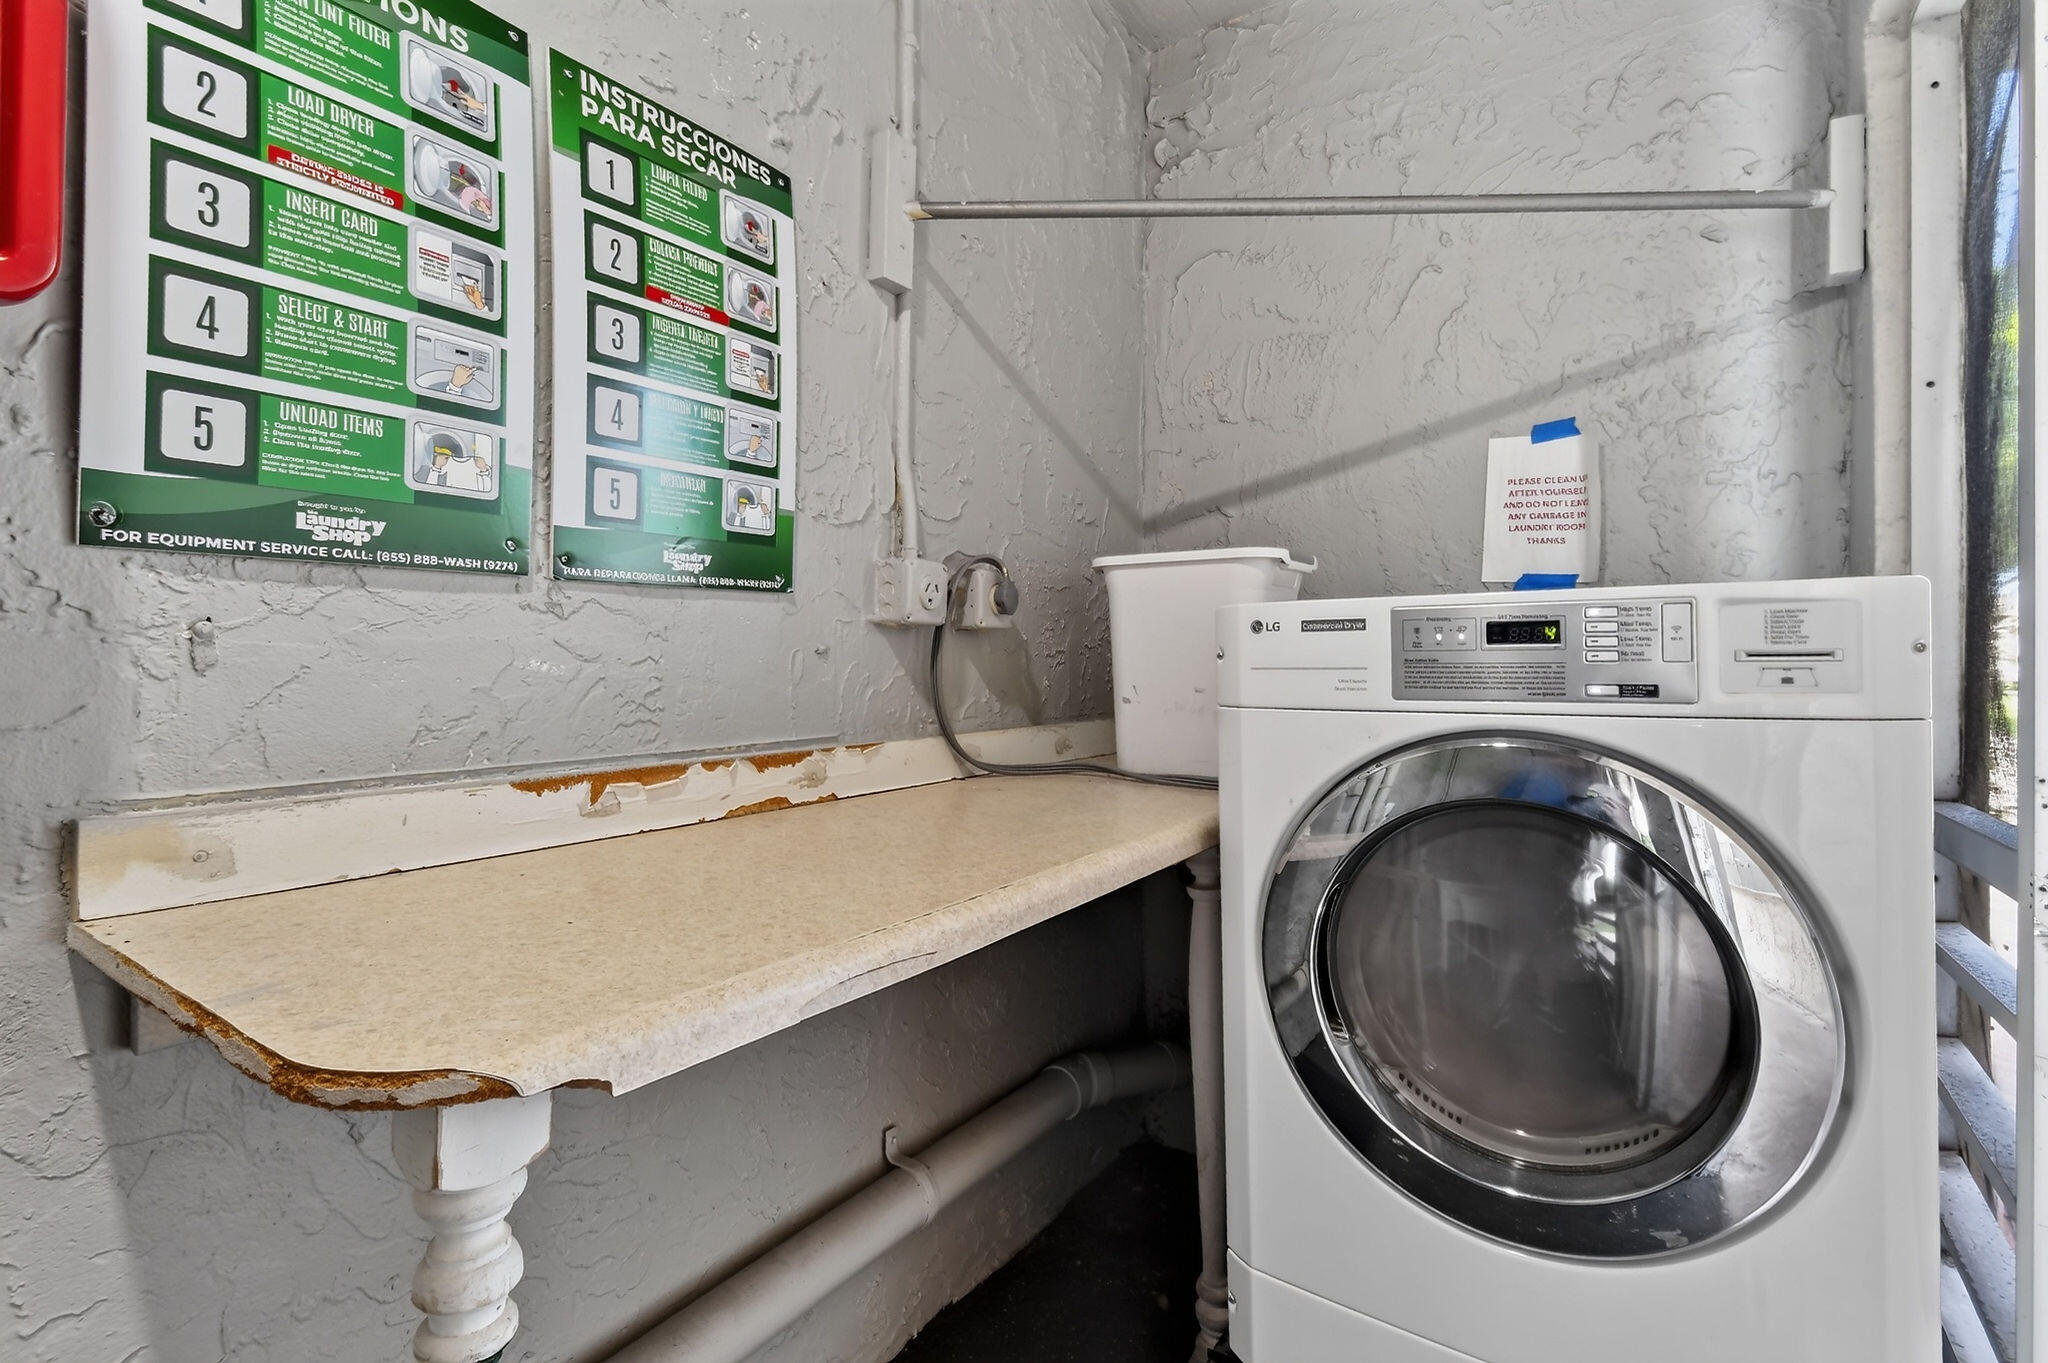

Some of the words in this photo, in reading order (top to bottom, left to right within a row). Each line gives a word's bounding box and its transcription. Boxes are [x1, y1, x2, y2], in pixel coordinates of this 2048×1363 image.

[348, 13, 391, 50] FILTER
[196, 70, 217, 118] 2
[288, 85, 325, 118] LOAD
[330, 103, 375, 138] DRYER
[579, 68, 772, 187] INSTRUCCIONES
[580, 93, 656, 150] PARA
[661, 135, 737, 190] SECAR
[374, 184, 386, 195] IS
[606, 158, 616, 191] 1
[198, 181, 220, 228] 3
[285, 189, 337, 223] INSERT
[341, 208, 378, 237] CARD
[609, 238, 621, 272] 2
[195, 295, 219, 340] 4
[278, 293, 330, 325] SELECT
[333, 308, 345, 329] &
[348, 312, 389, 340] START
[611, 317, 625, 351] 3
[193, 405, 213, 452] 5
[279, 401, 338, 430] UNLOAD
[343, 413, 384, 438] ITEMS
[610, 398, 625, 431] 4
[609, 477, 621, 510] 5
[1507, 477, 1541, 486] PLEASE
[1544, 476, 1577, 485] CLEAN
[1508, 489, 1538, 498] AFTER
[1503, 501, 1524, 509] AND
[1525, 500, 1541, 508] DO
[1543, 500, 1563, 508] NOT
[1508, 512, 1527, 520] ANY
[1529, 511, 1575, 520] GARBAGE
[1577, 511, 1587, 519] IN
[296, 510, 388, 538] Laundry
[1508, 524, 1554, 532] LAUNDRY
[1556, 523, 1586, 531] ROOM
[1527, 537, 1566, 545] THANKS
[101, 528, 142, 544] FOR
[147, 531, 257, 552] EQUIPMENT
[260, 541, 329, 558] SERVICE
[332, 547, 374, 561] CALL:
[483, 559, 519, 573] (9274)
[1265, 621, 1281, 632] LG
[1302, 621, 1343, 631] Commercial
[1344, 620, 1365, 631] Dryer
